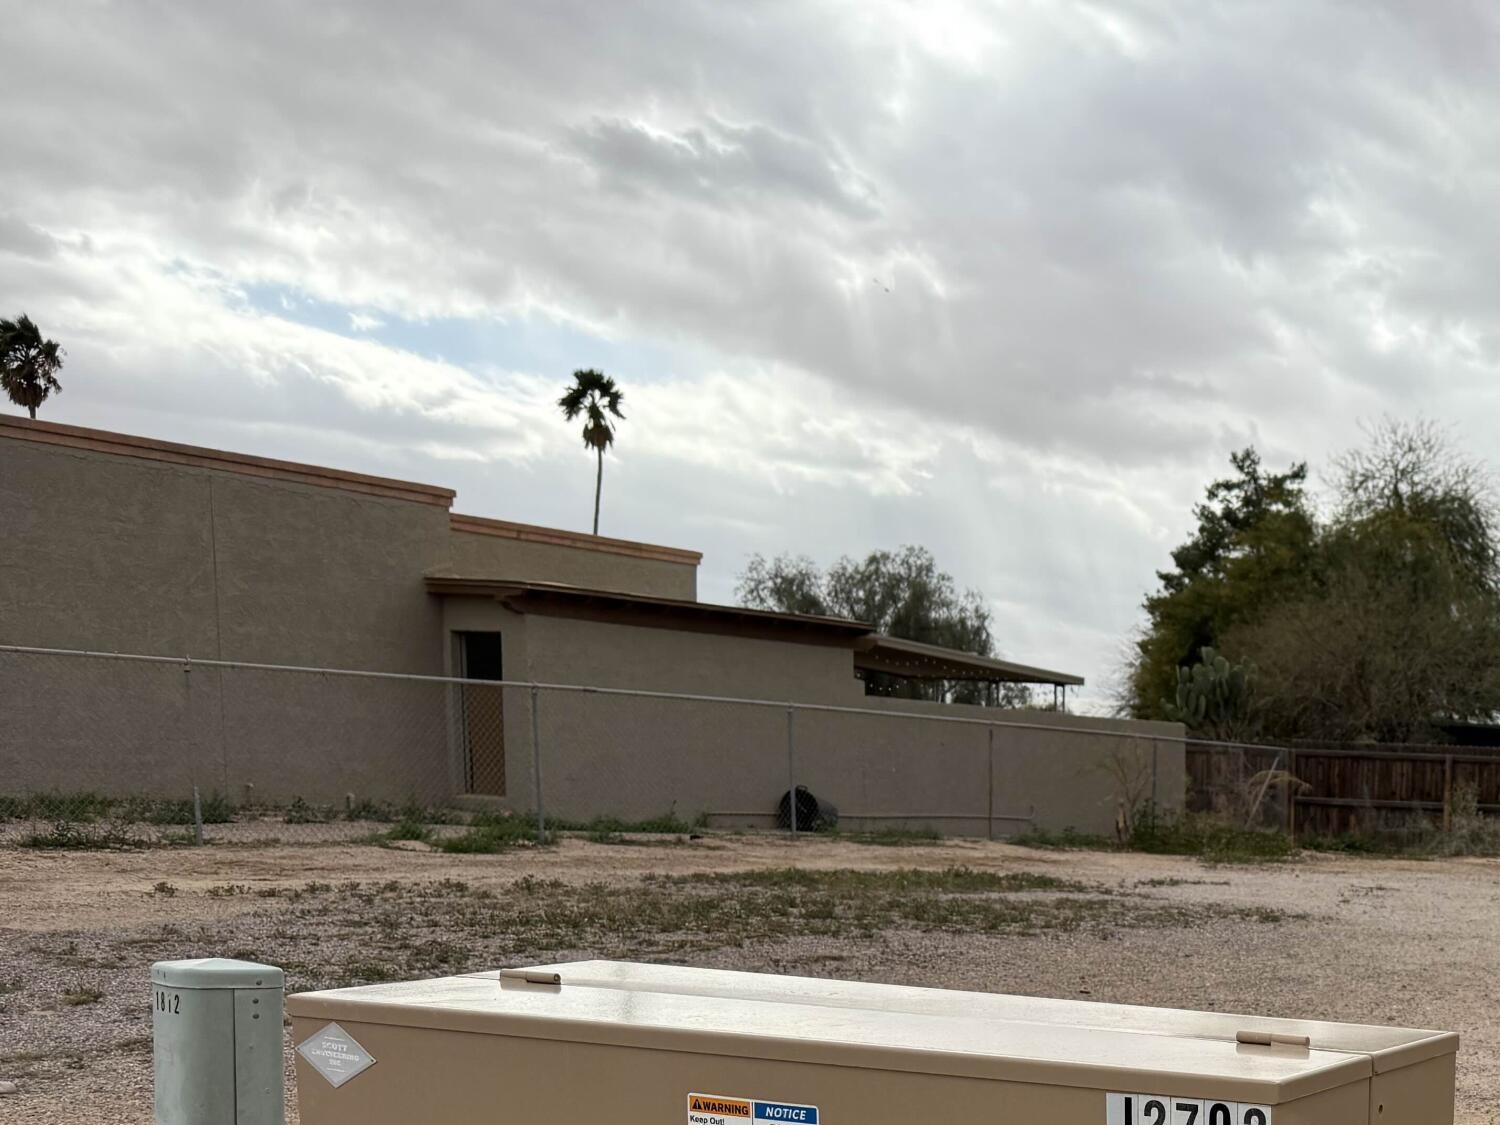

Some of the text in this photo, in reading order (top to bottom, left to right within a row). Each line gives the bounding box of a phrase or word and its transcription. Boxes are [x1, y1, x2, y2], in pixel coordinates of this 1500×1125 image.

[703, 1101, 748, 1115] WARNING
[765, 1106, 807, 1120] NOTICE
[690, 1115, 724, 1125] Keep Out!
